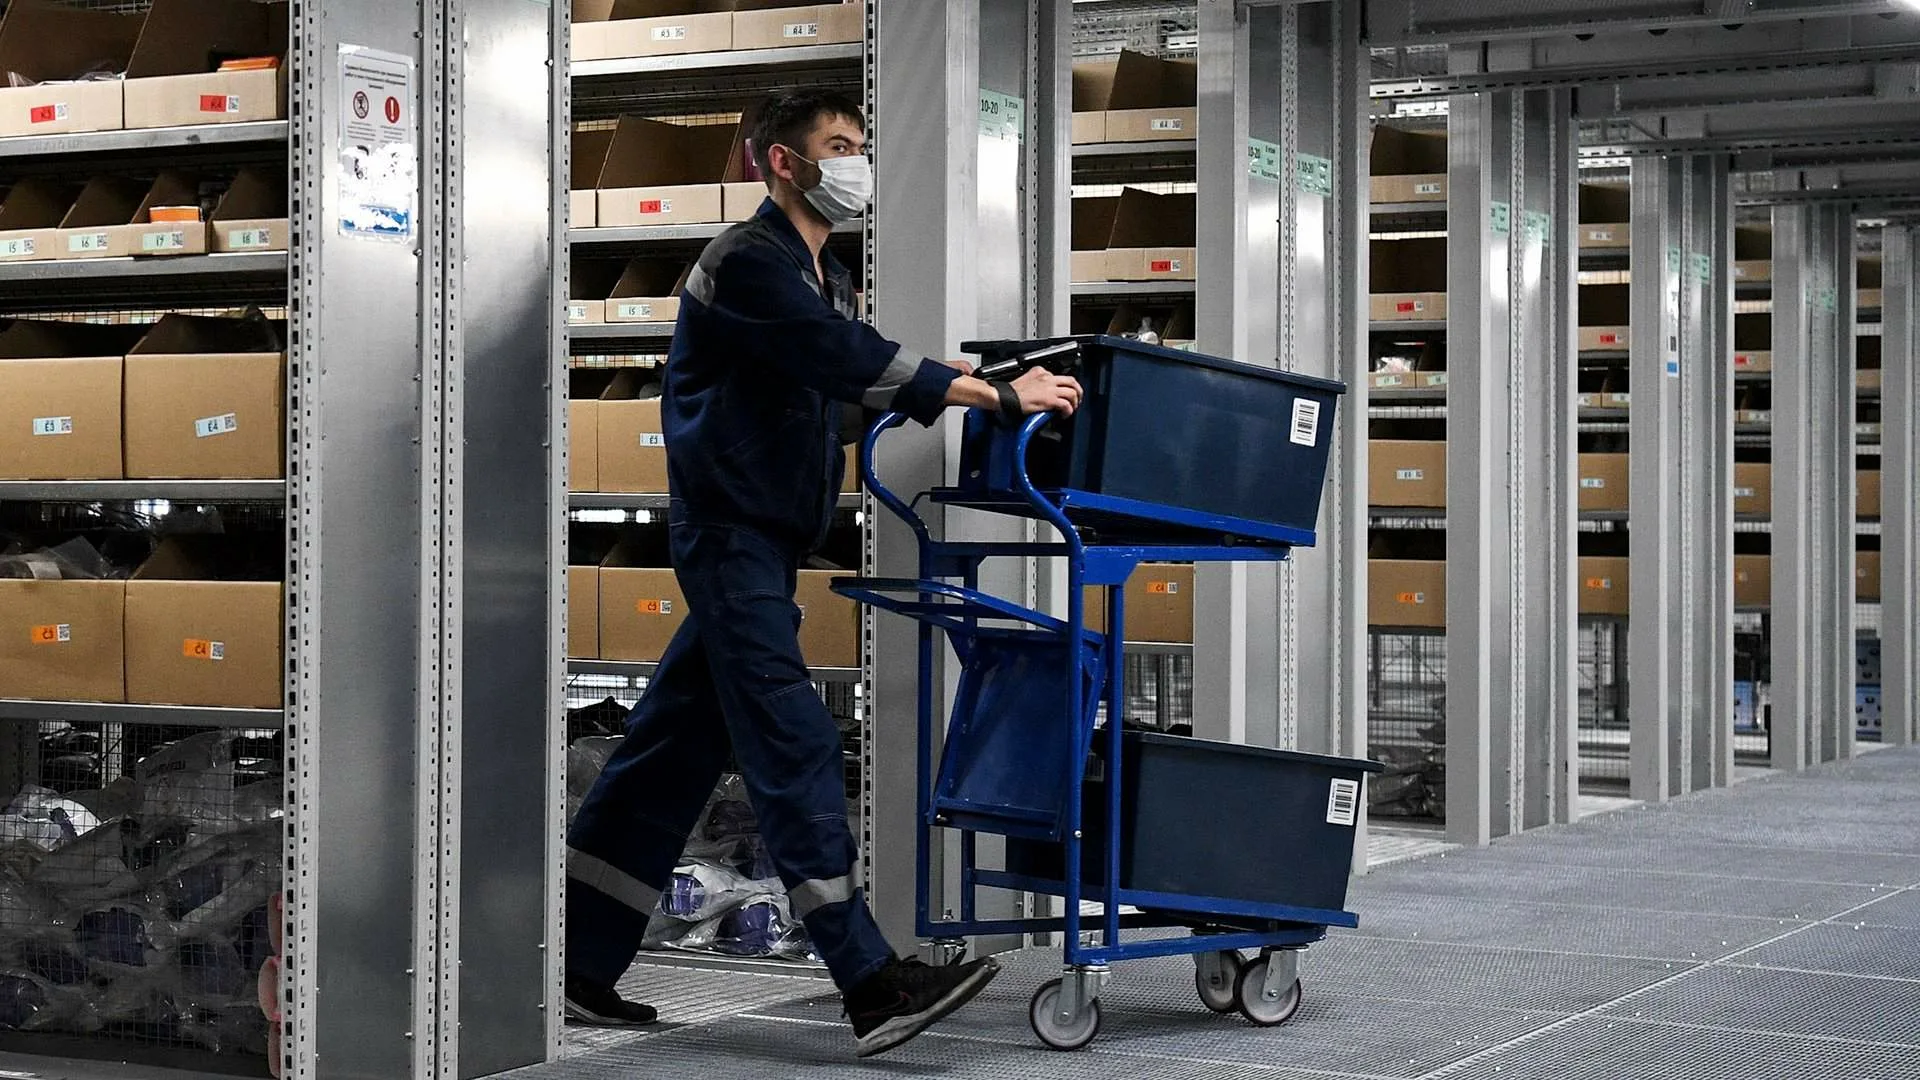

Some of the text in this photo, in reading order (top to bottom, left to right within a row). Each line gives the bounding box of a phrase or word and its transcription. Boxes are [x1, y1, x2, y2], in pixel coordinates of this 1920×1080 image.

[981, 99, 998, 115] 10-20
[45, 422, 55, 432] E3
[207, 421, 218, 433] E4
[649, 435, 658, 444] E3
[42, 629, 54, 640] C3
[194, 643, 206, 655] C4
